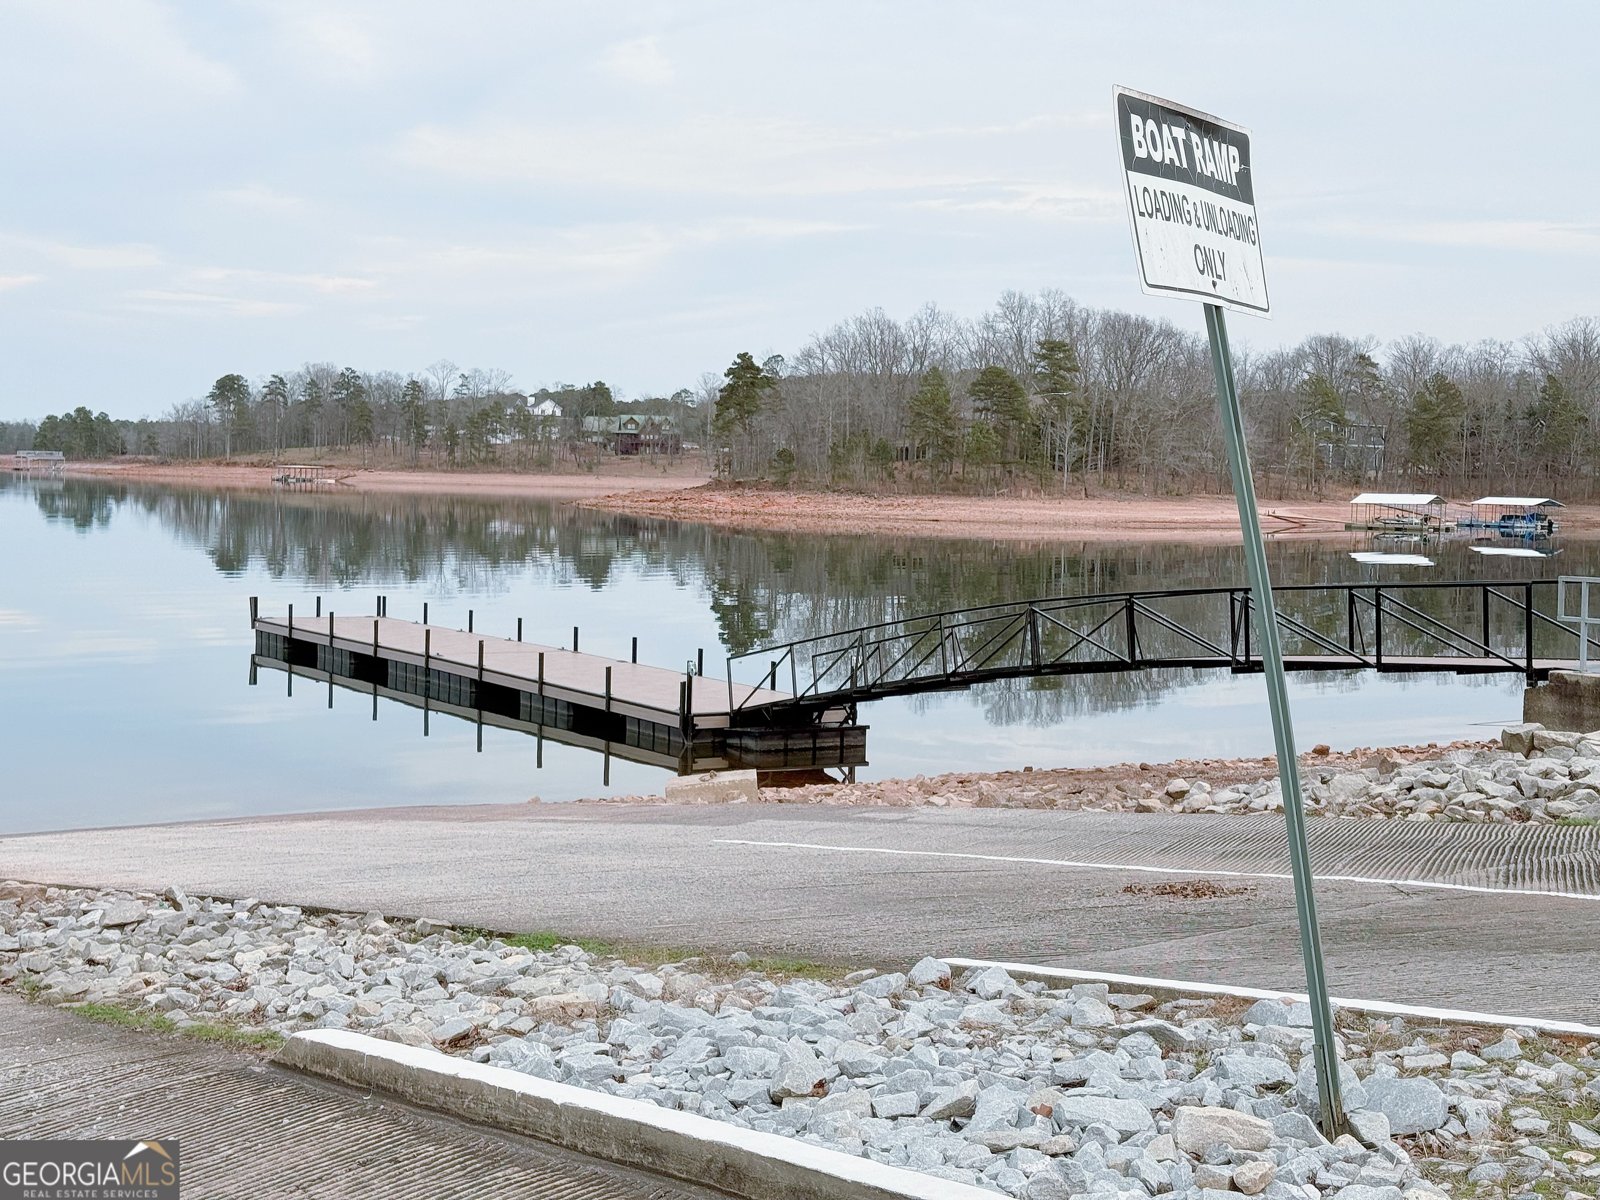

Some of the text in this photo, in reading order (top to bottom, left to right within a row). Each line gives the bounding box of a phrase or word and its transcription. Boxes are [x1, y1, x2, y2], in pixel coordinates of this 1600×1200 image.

[1130, 113, 1240, 186] BOAT RAMP
[1134, 185, 1257, 247] LOADING & UNLOADING
[1194, 244, 1226, 282] ONLY
